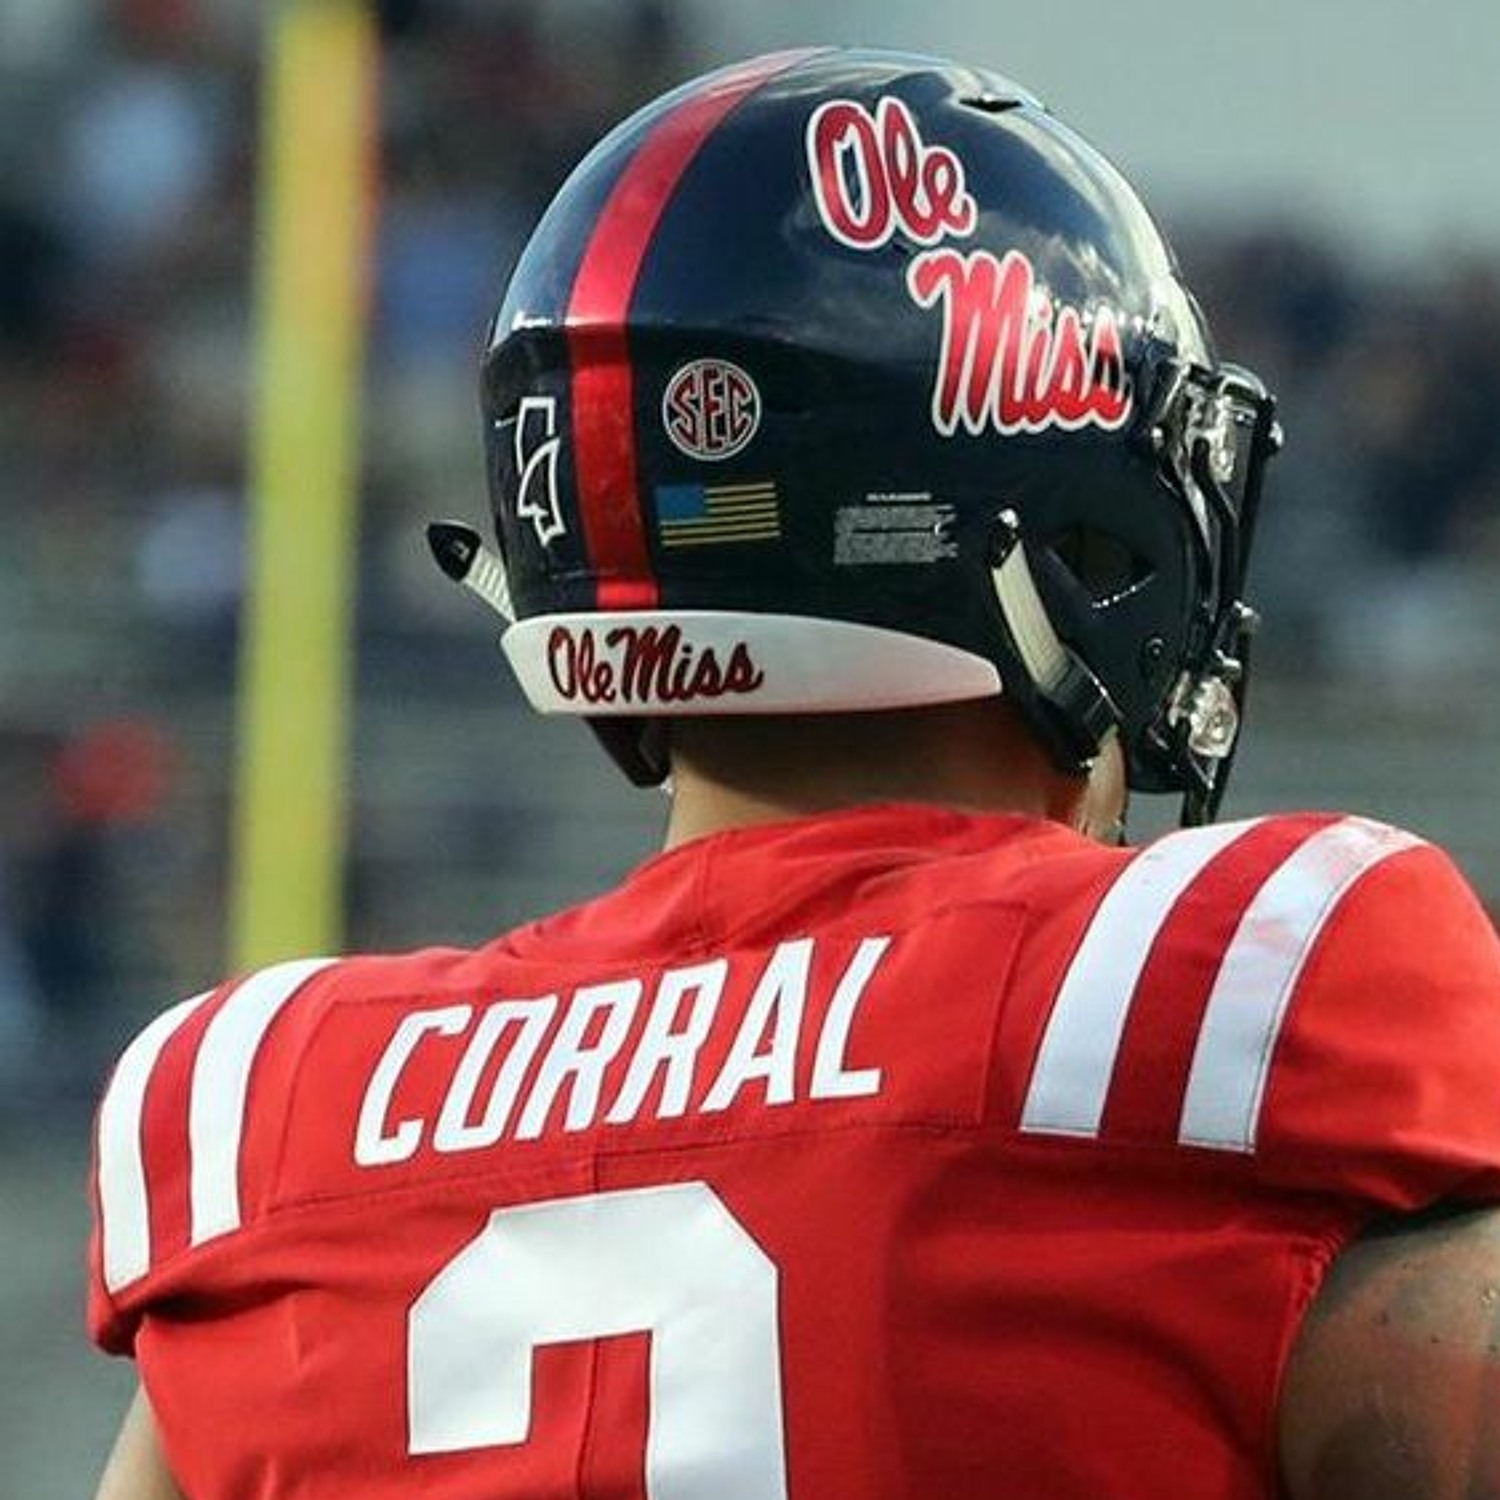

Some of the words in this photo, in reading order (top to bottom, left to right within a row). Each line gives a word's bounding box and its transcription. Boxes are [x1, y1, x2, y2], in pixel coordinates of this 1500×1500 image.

[808, 97, 976, 249] Ole
[671, 364, 752, 453] SEC
[908, 251, 1133, 436] Miss
[548, 626, 616, 704] Ole
[605, 624, 764, 703] Miss
[354, 937, 893, 1166] CORRAL
